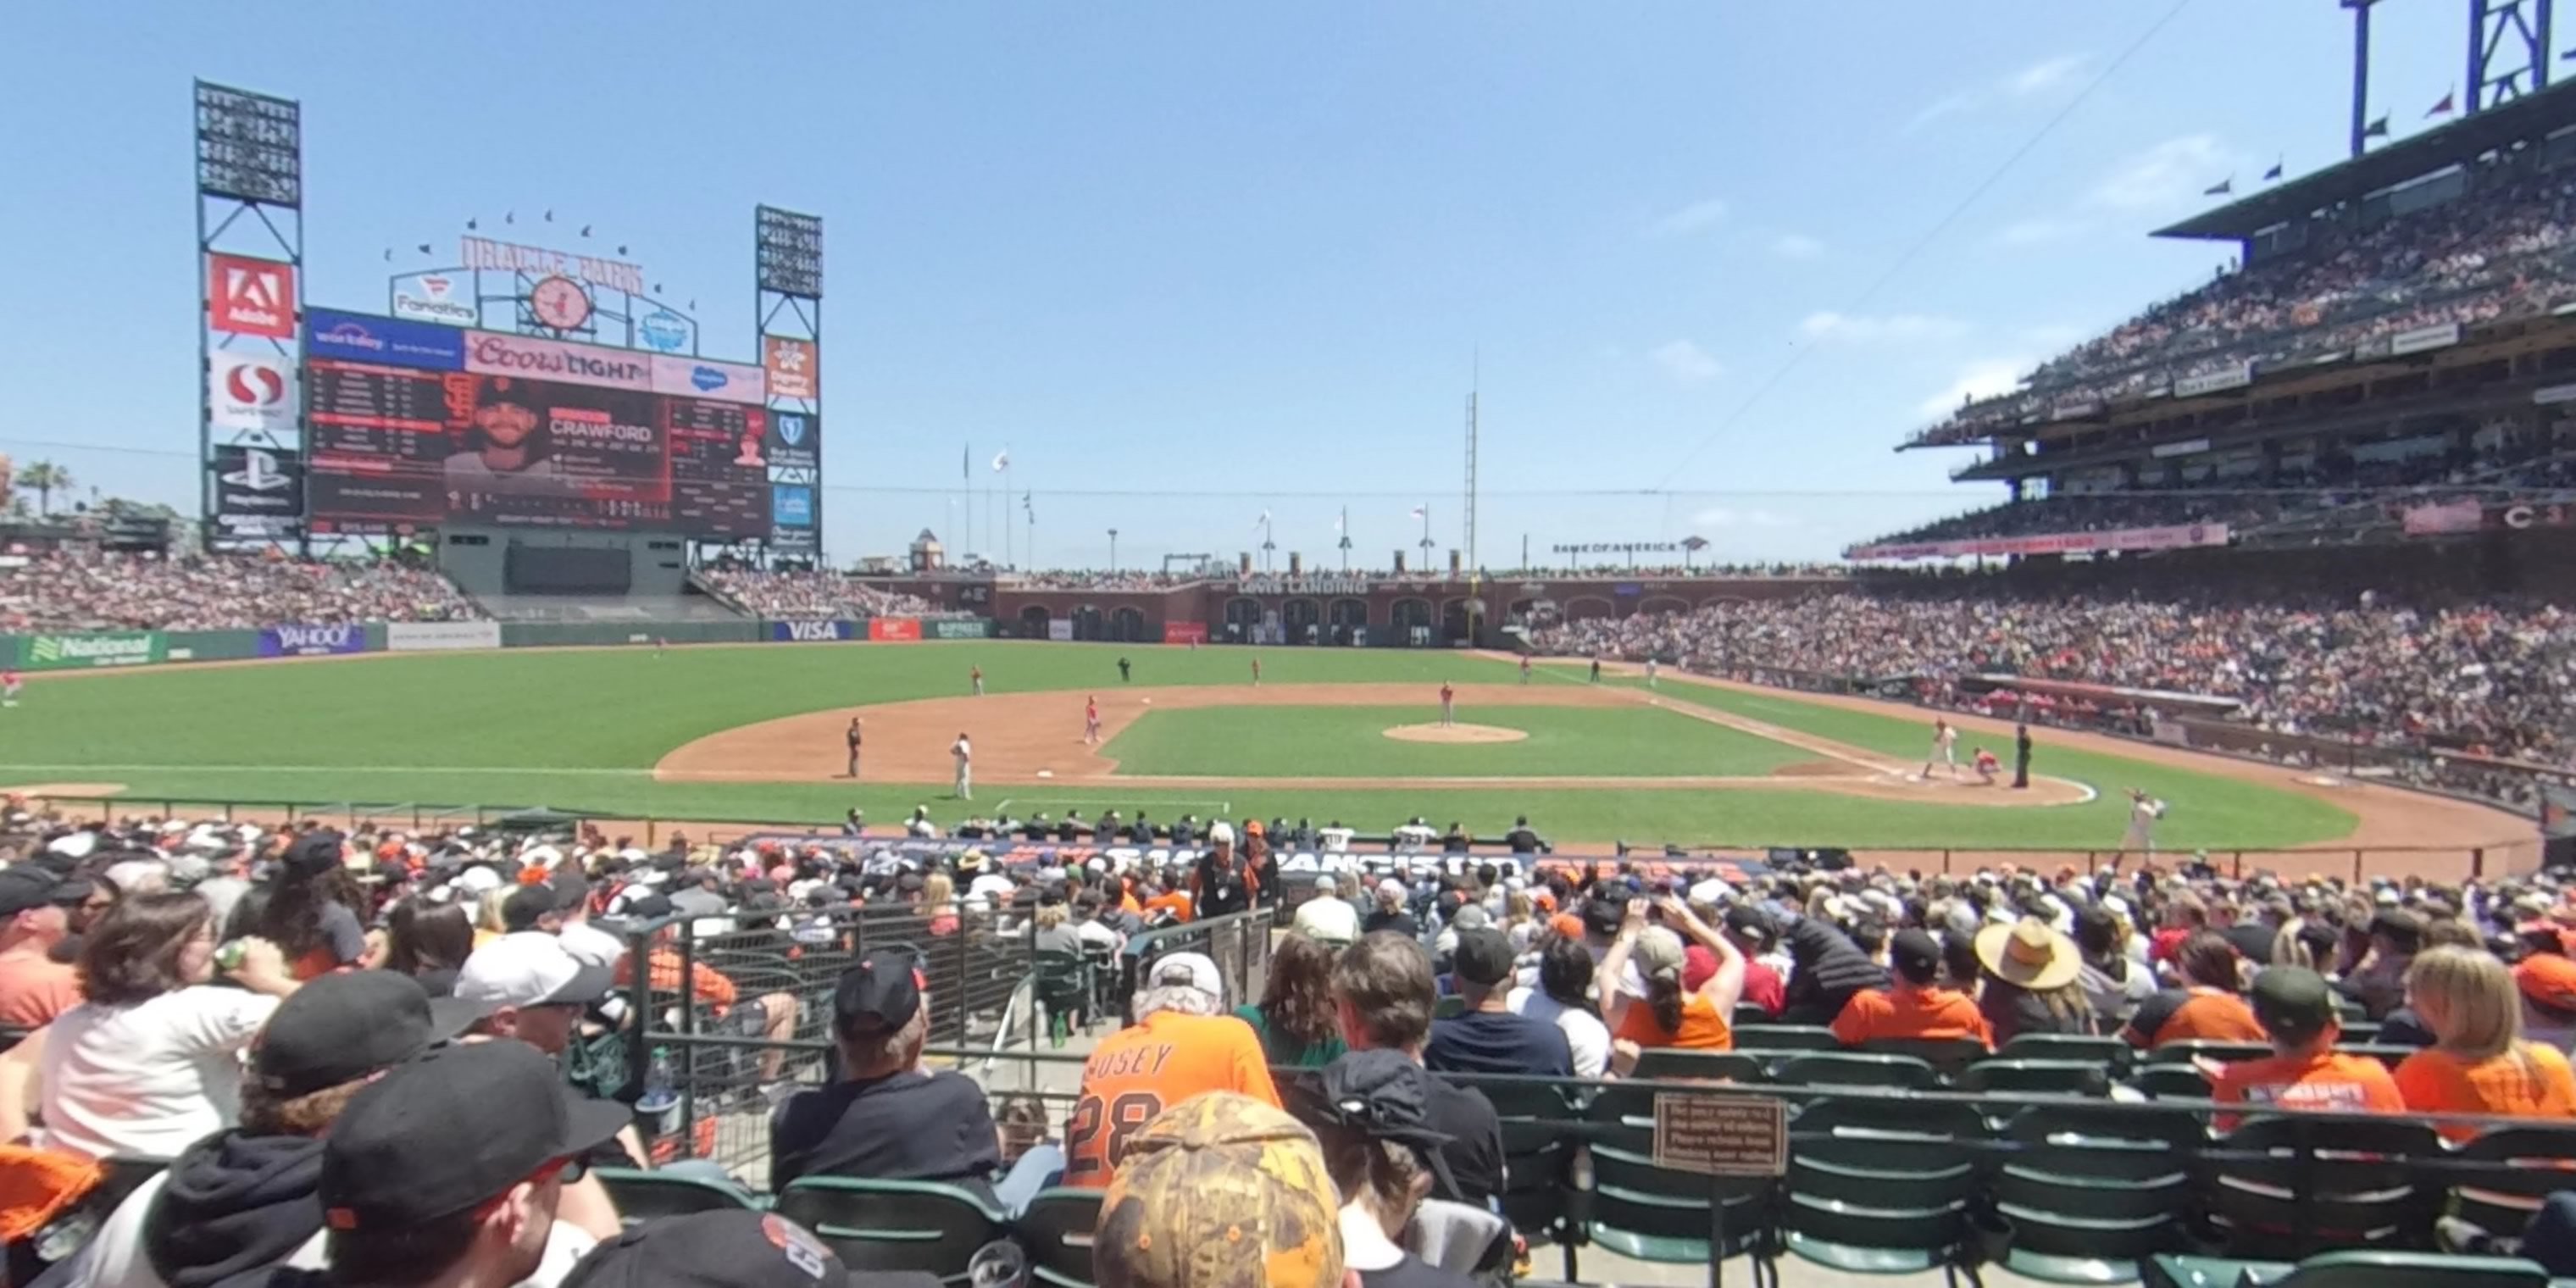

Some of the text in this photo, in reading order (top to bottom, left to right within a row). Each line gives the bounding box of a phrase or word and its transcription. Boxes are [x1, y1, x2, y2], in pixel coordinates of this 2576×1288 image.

[228, 305, 279, 326] Adobe
[397, 295, 475, 320] Fanatics
[473, 336, 562, 373] Coors
[563, 350, 642, 380] LIGHT
[549, 419, 652, 442] CRAWFORD
[1613, 543, 1677, 553] AMERICA
[276, 623, 350, 648] YAHOO!
[786, 620, 838, 640] VISA
[60, 635, 151, 658] National
[1069, 1092, 1162, 1173] 28
